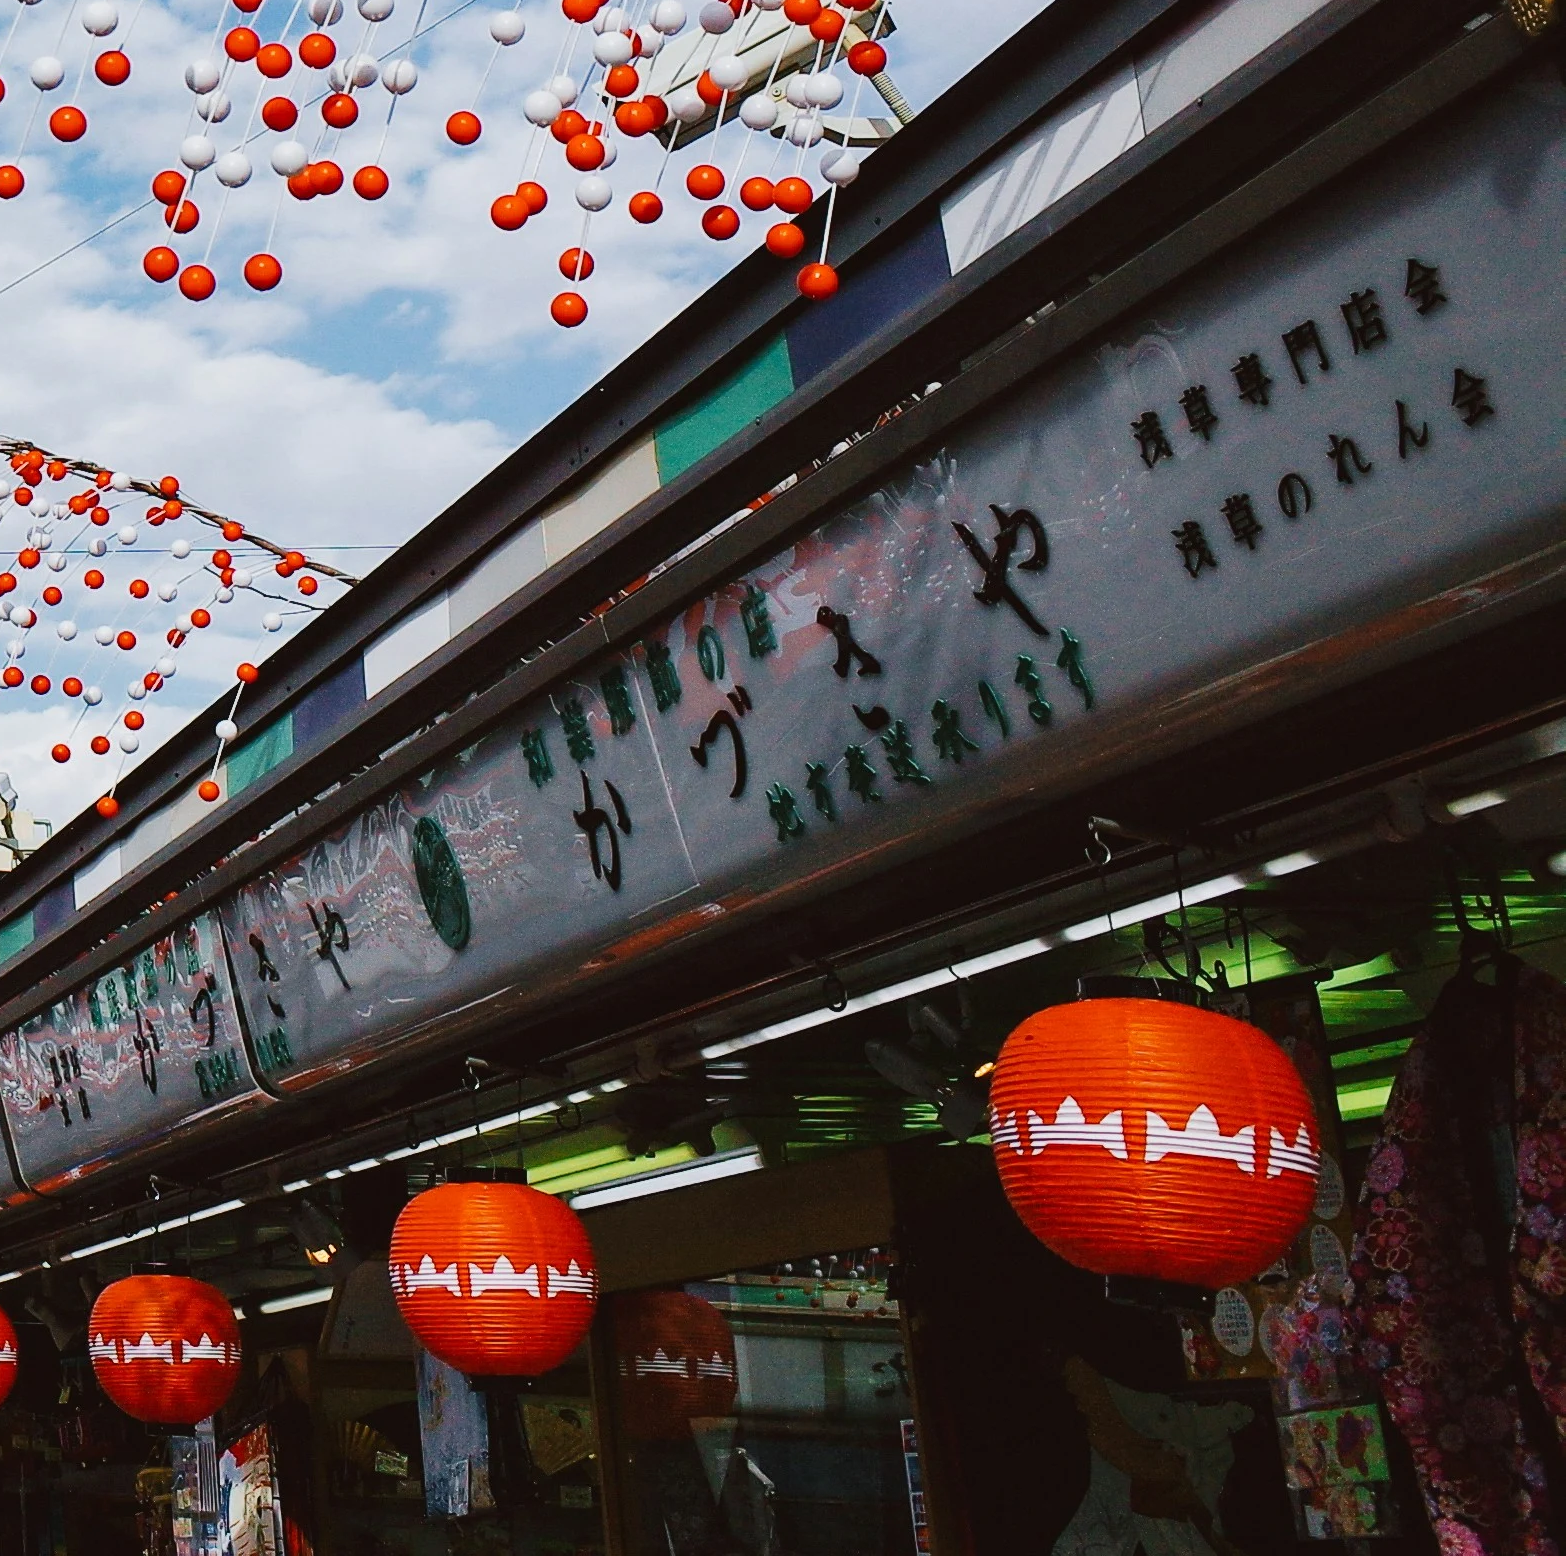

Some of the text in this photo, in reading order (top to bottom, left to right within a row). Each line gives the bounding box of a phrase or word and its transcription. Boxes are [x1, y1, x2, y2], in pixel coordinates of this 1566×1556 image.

[1172, 368, 1495, 578] 浅草のれん会
